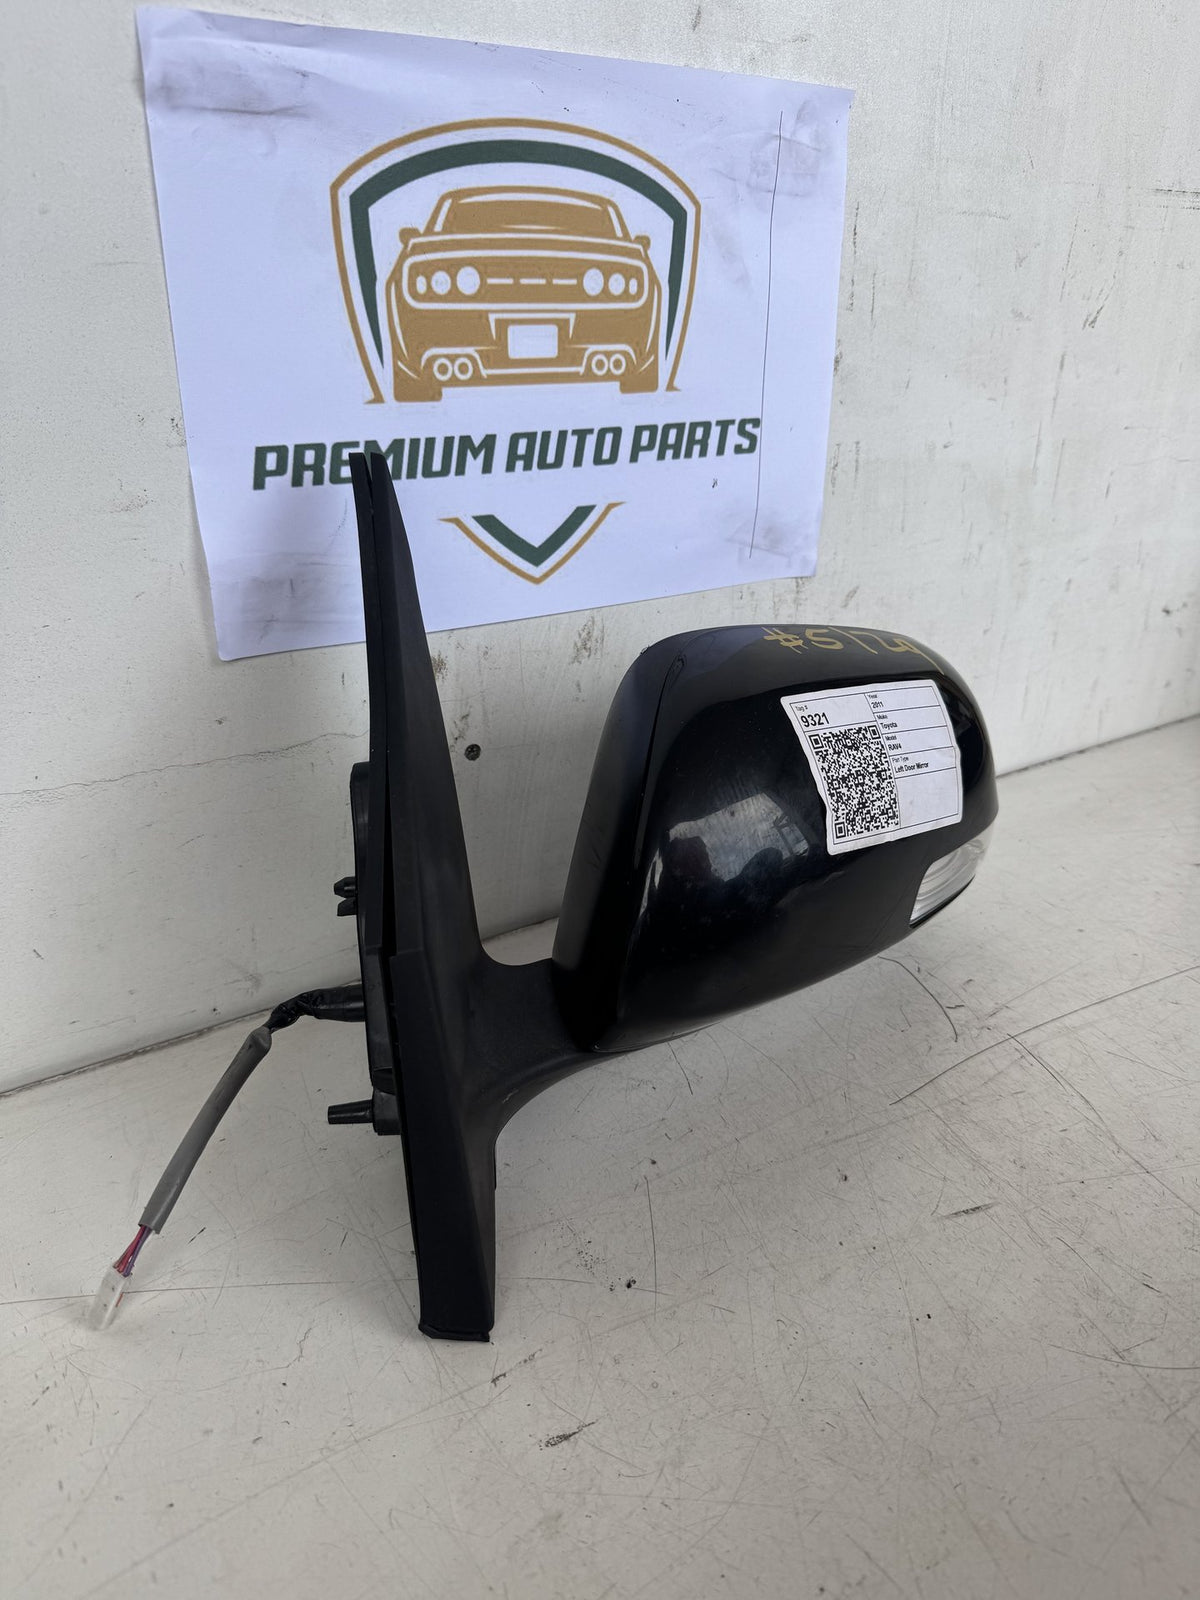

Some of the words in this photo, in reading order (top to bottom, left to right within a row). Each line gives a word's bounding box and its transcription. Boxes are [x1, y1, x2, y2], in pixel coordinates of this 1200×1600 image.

[252, 434, 497, 490] PREMIUM
[505, 427, 622, 472] AUTO
[629, 418, 761, 463] PARTS
[801, 712, 829, 728] 9321
[880, 722, 898, 730] Toyota
[888, 743, 902, 751] RAV4
[894, 765, 904, 773] Left
